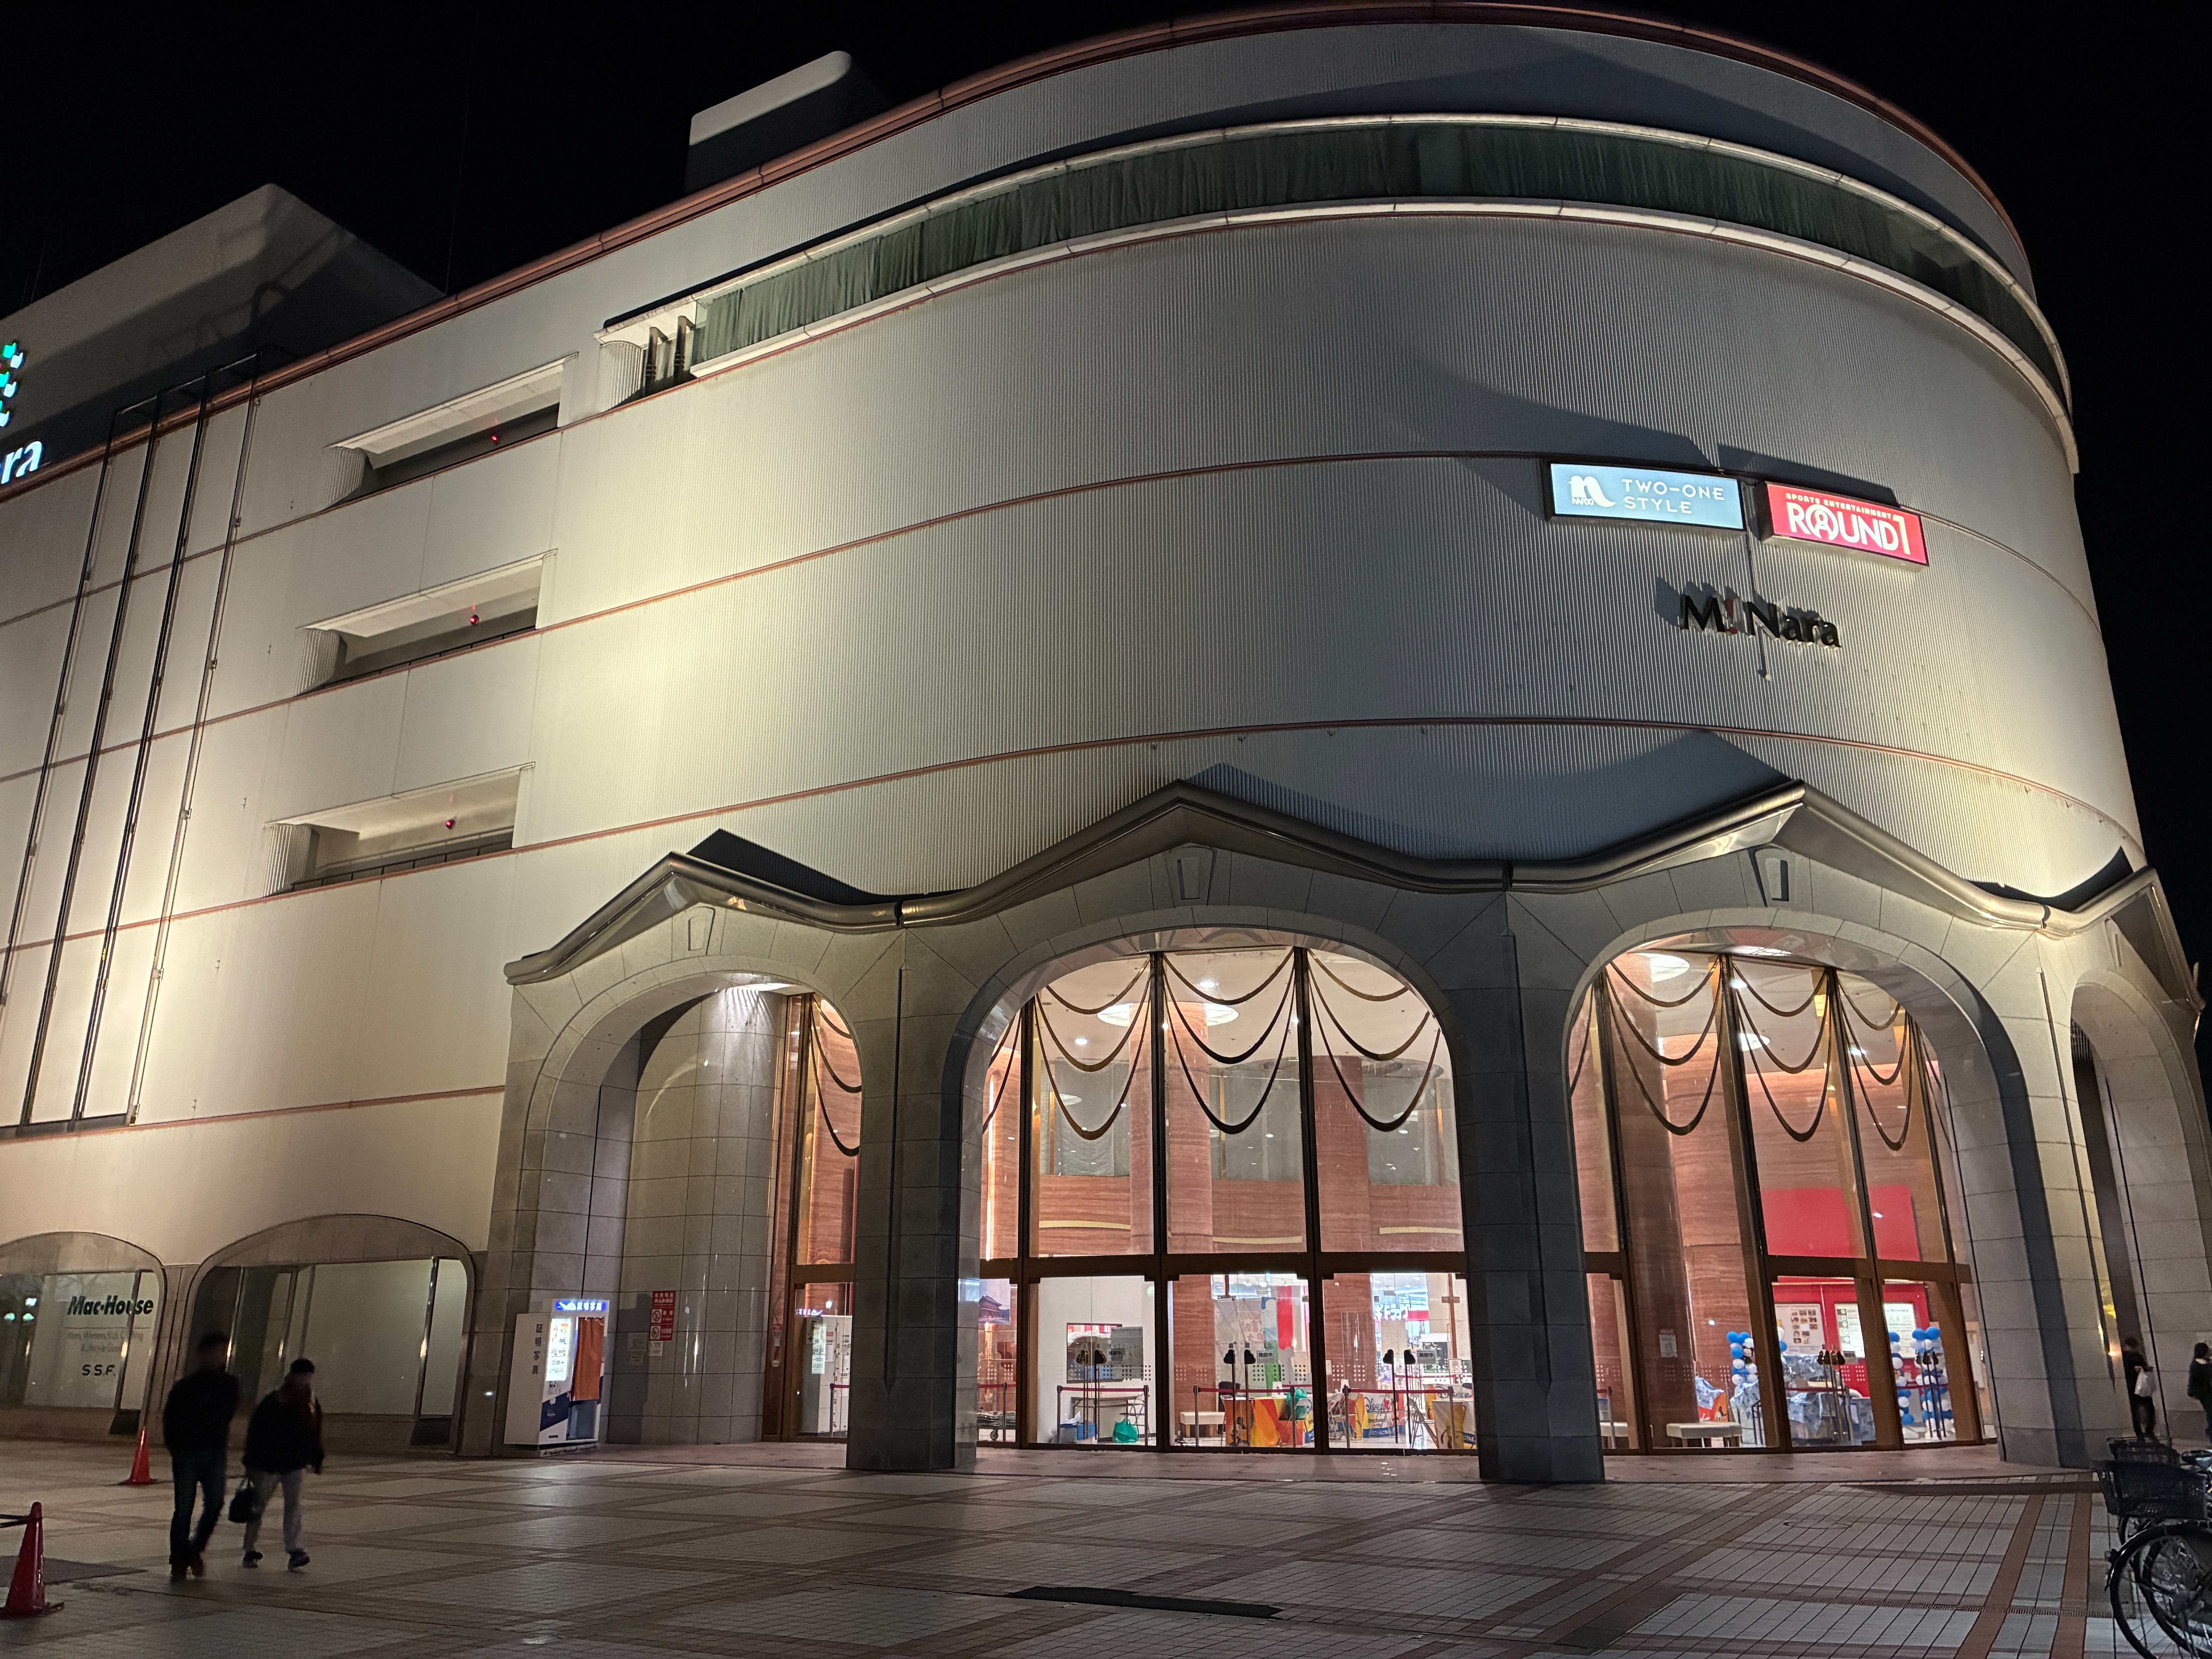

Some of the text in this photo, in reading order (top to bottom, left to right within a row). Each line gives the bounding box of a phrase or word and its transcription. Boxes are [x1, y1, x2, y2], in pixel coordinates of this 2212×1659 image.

[1621, 478, 1725, 501] TWO-ONE
[1624, 496, 1693, 514] STYLE
[1786, 492, 1892, 520] SPORTS ENTERTAINMENT
